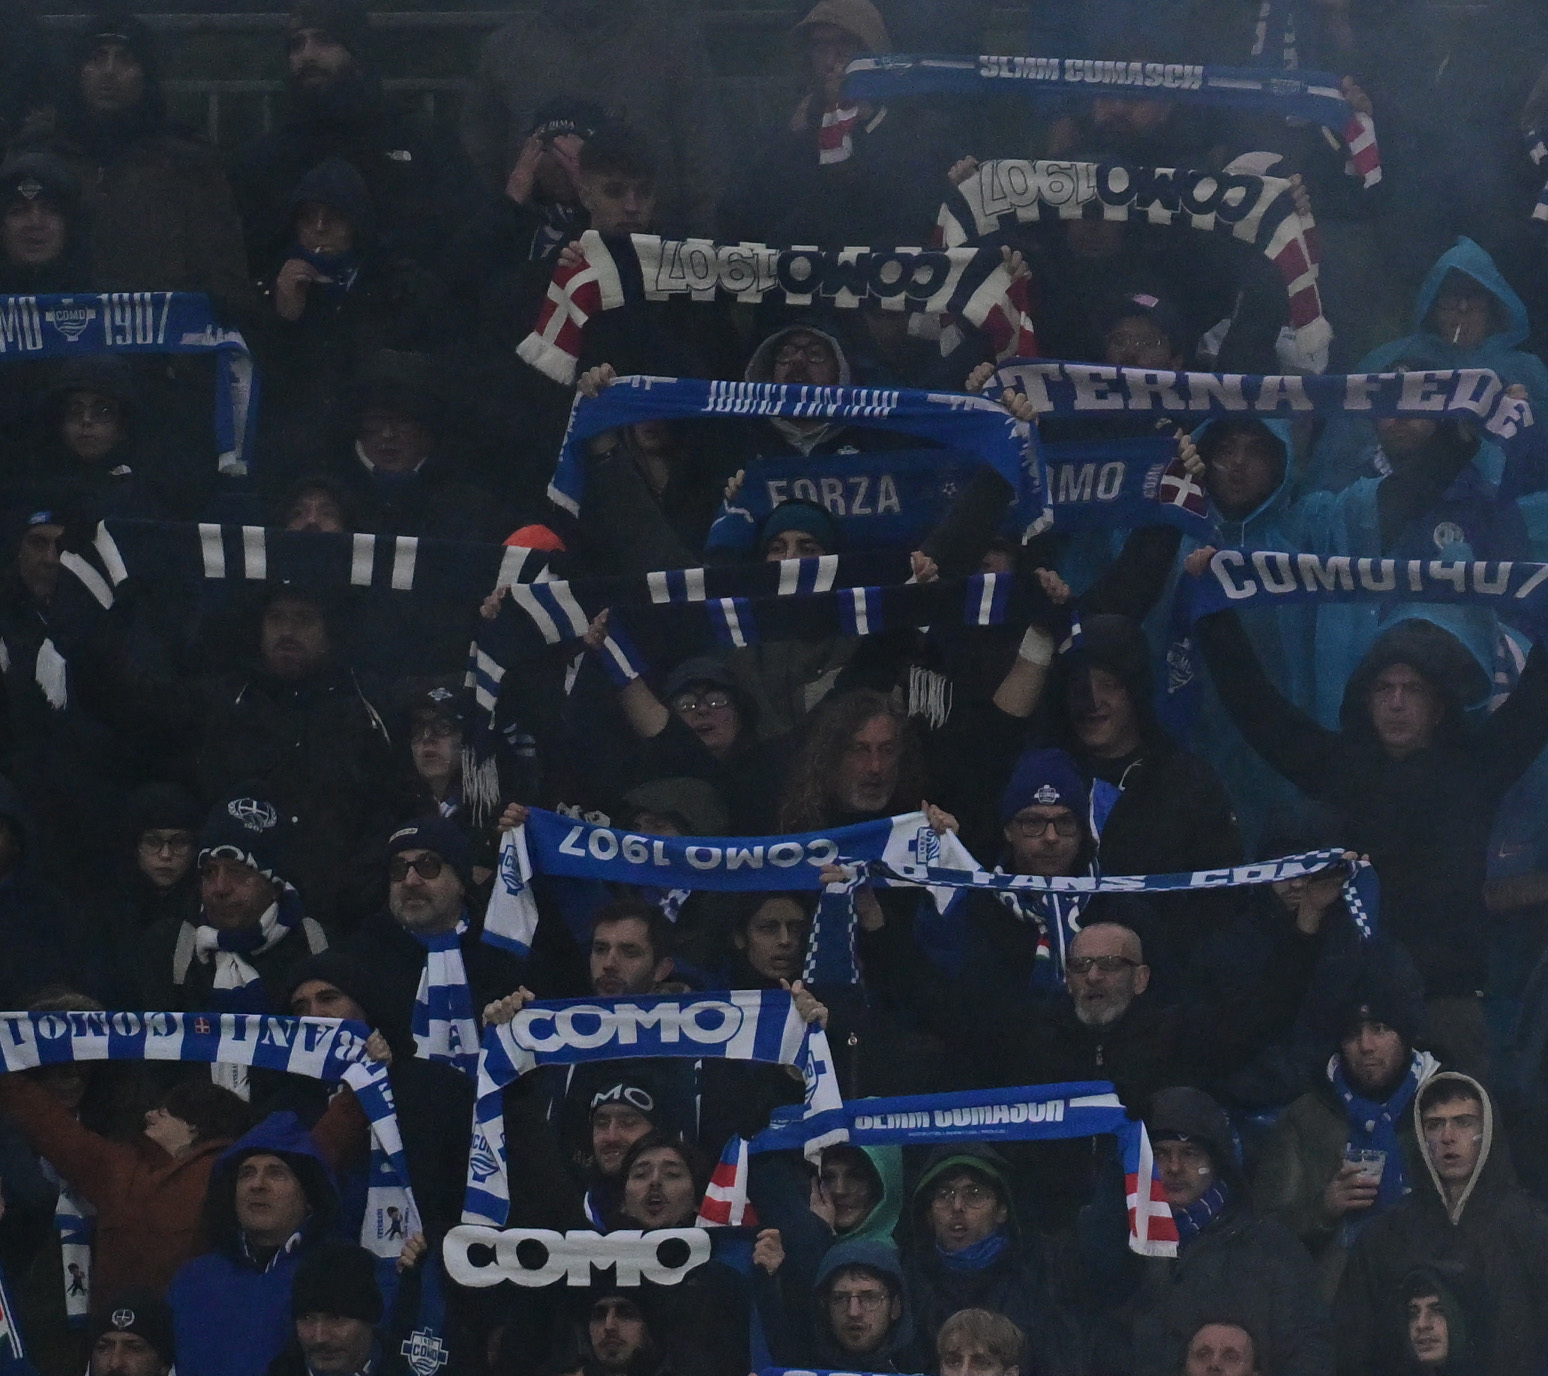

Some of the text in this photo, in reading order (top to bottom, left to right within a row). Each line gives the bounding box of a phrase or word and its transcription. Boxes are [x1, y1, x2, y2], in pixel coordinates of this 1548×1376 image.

[103, 290, 174, 346] 1907
[558, 826, 842, 874] COMO 1907
[509, 996, 747, 1049] COMO
[442, 1225, 712, 1290] COMO
